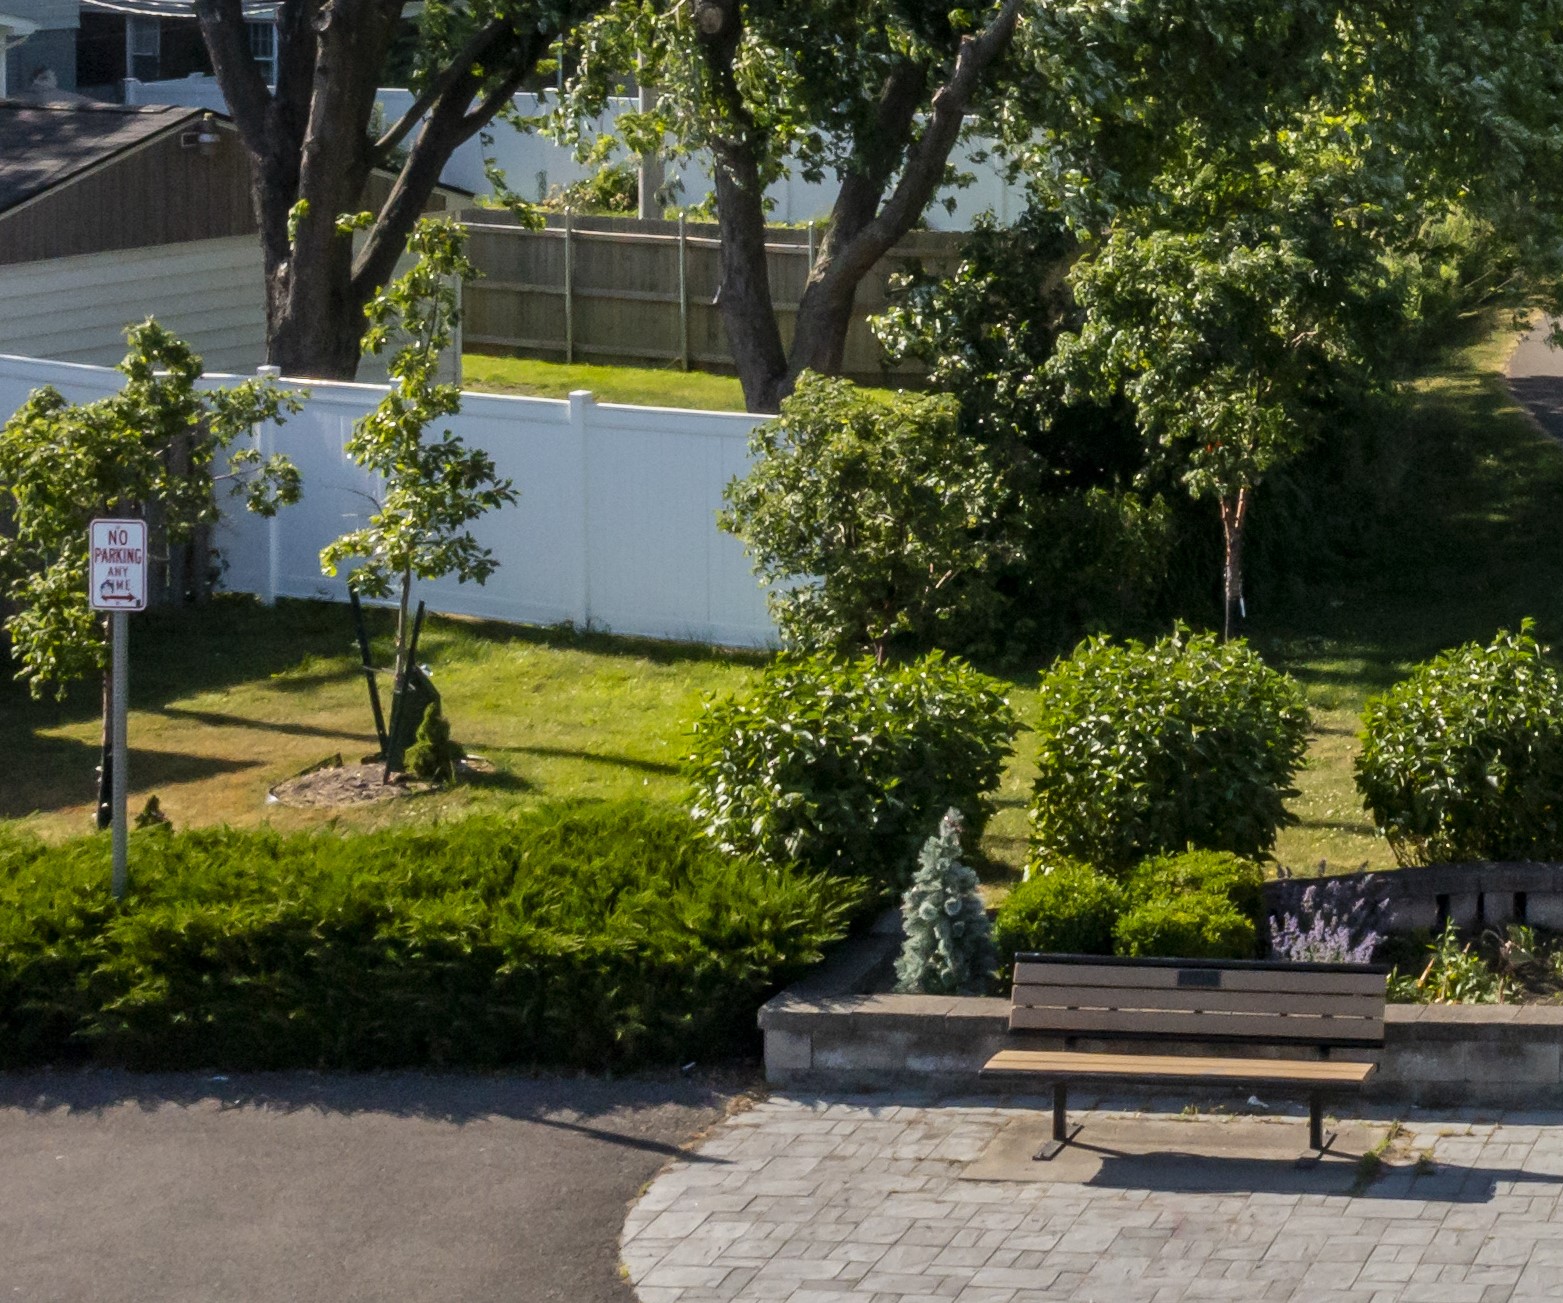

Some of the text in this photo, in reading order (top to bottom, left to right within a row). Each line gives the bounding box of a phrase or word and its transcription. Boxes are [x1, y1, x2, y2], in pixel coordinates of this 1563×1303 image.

[108, 530, 128, 546] NO
[94, 547, 142, 564] PARKING
[108, 566, 129, 577] ANY
[105, 578, 131, 591] ME
